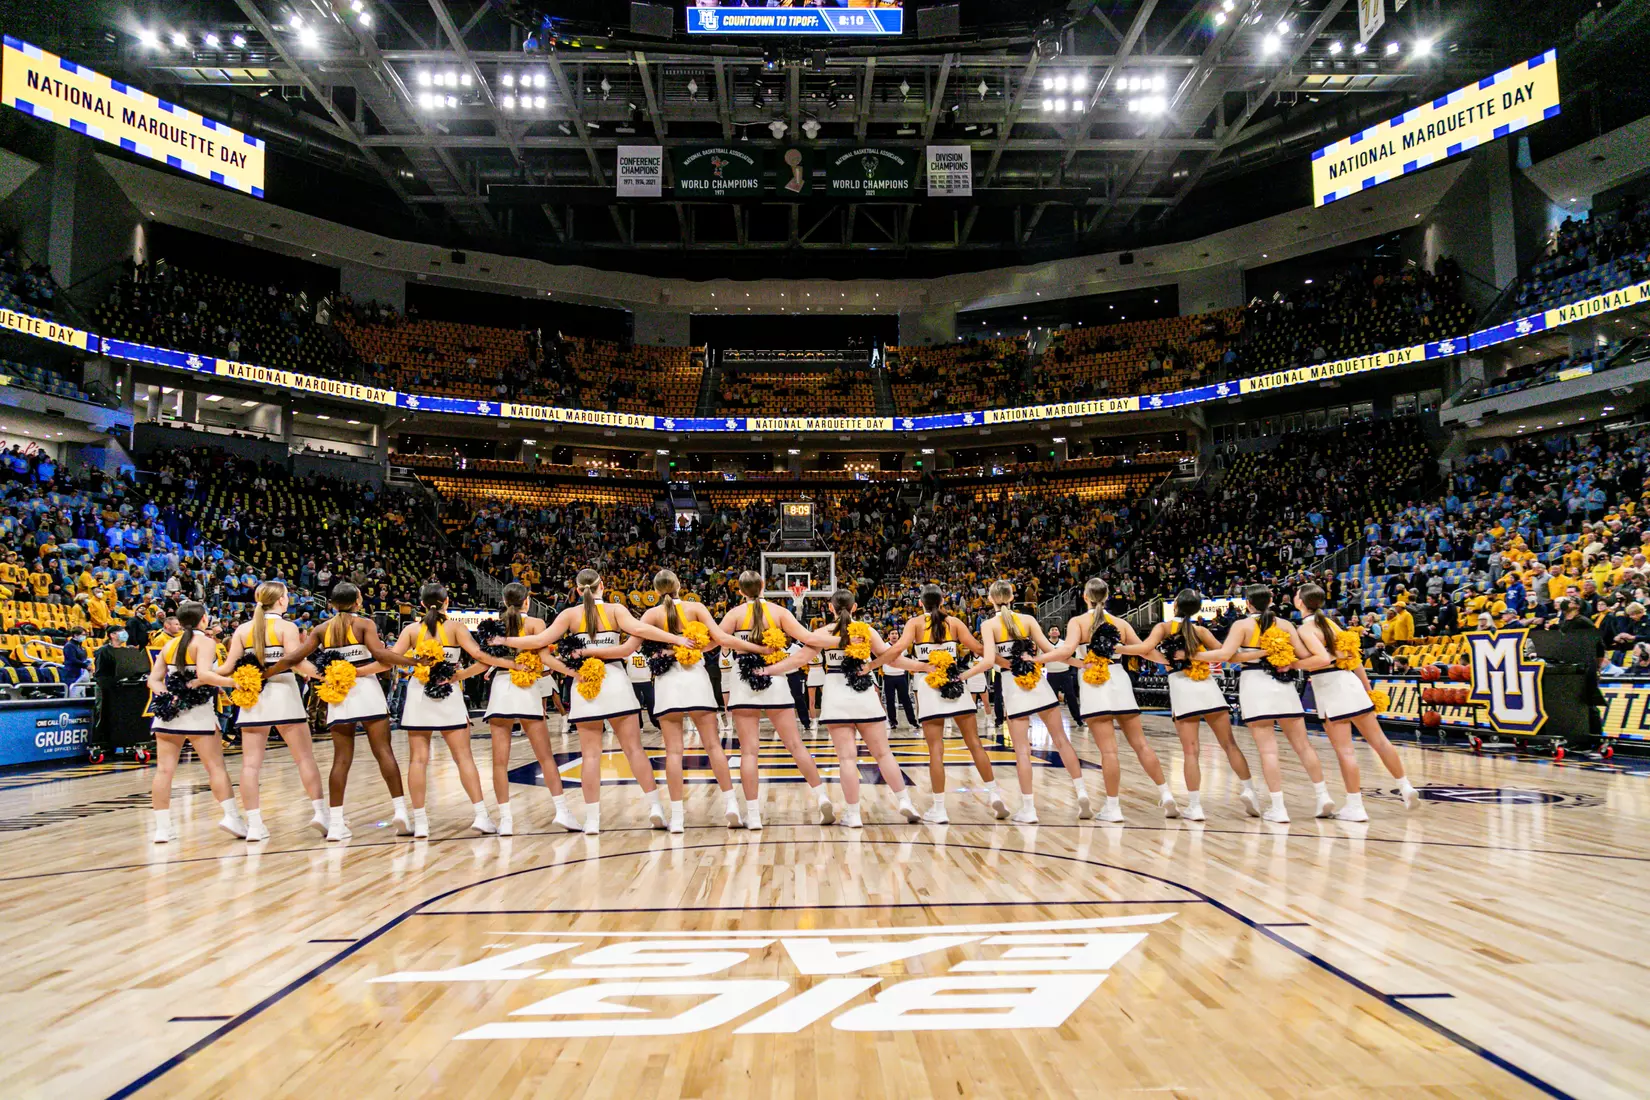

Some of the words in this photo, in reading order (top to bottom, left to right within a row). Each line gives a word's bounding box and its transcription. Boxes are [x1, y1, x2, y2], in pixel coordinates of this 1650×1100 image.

[722, 15, 775, 27] COUNTDOWN
[776, 16, 787, 27] TO
[788, 15, 819, 27] TIPOFF:
[838, 15, 864, 26] 8:10
[27, 69, 114, 119] NATIONAL
[122, 107, 214, 157] MARQUETTE
[221, 146, 247, 169] DAY
[1329, 141, 1396, 180] NATIONAL
[1402, 98, 1496, 150] MARQUETTE
[1503, 81, 1534, 110] DAY
[619, 157, 661, 166] CONFERENCE
[683, 153, 702, 166] NATIONAL
[702, 148, 728, 156] BASKETBALL
[729, 149, 755, 166] ASSOCIATION
[835, 153, 853, 166] NATIONAL
[853, 148, 879, 156] BASKETBALL
[880, 149, 905, 166] ASSOCIATION
[935, 153, 963, 161] DIVISION
[621, 166, 659, 175] CHAMPIONS
[930, 162, 969, 171] CHAMPIONS
[681, 179, 709, 189] WORLD
[712, 179, 759, 189] CHAMPIONS
[832, 180, 860, 189] WORLD
[863, 179, 909, 189] CHAMPIONS
[1559, 291, 1630, 322] NATIONAL
[49, 325, 74, 343] DAY
[1250, 367, 1304, 390] NATIONAL
[1310, 357, 1381, 379] MARQUETTE
[1389, 349, 1412, 364] DAY
[228, 363, 288, 384] NATIONAL
[294, 375, 361, 398] MARQUETTE
[366, 388, 387, 402] DAY
[510, 406, 560, 420] NATIONAL
[565, 410, 623, 425] MARQUETTE
[628, 415, 645, 426] DAY
[993, 408, 1040, 421] NATIONAL
[1045, 402, 1104, 417] MARQUETTE
[1110, 399, 1129, 410] DAY
[755, 419, 802, 429] NATIONAL
[806, 419, 862, 429] MARQUETTE
[866, 419, 884, 429] DAY
[790, 505, 810, 515] 8:09
[632, 656, 646, 668] MU
[1466, 631, 1545, 731] MU
[35, 728, 89, 748] GRUBER
[366, 932, 1148, 984] EAST
[451, 973, 1109, 1040] BIG
